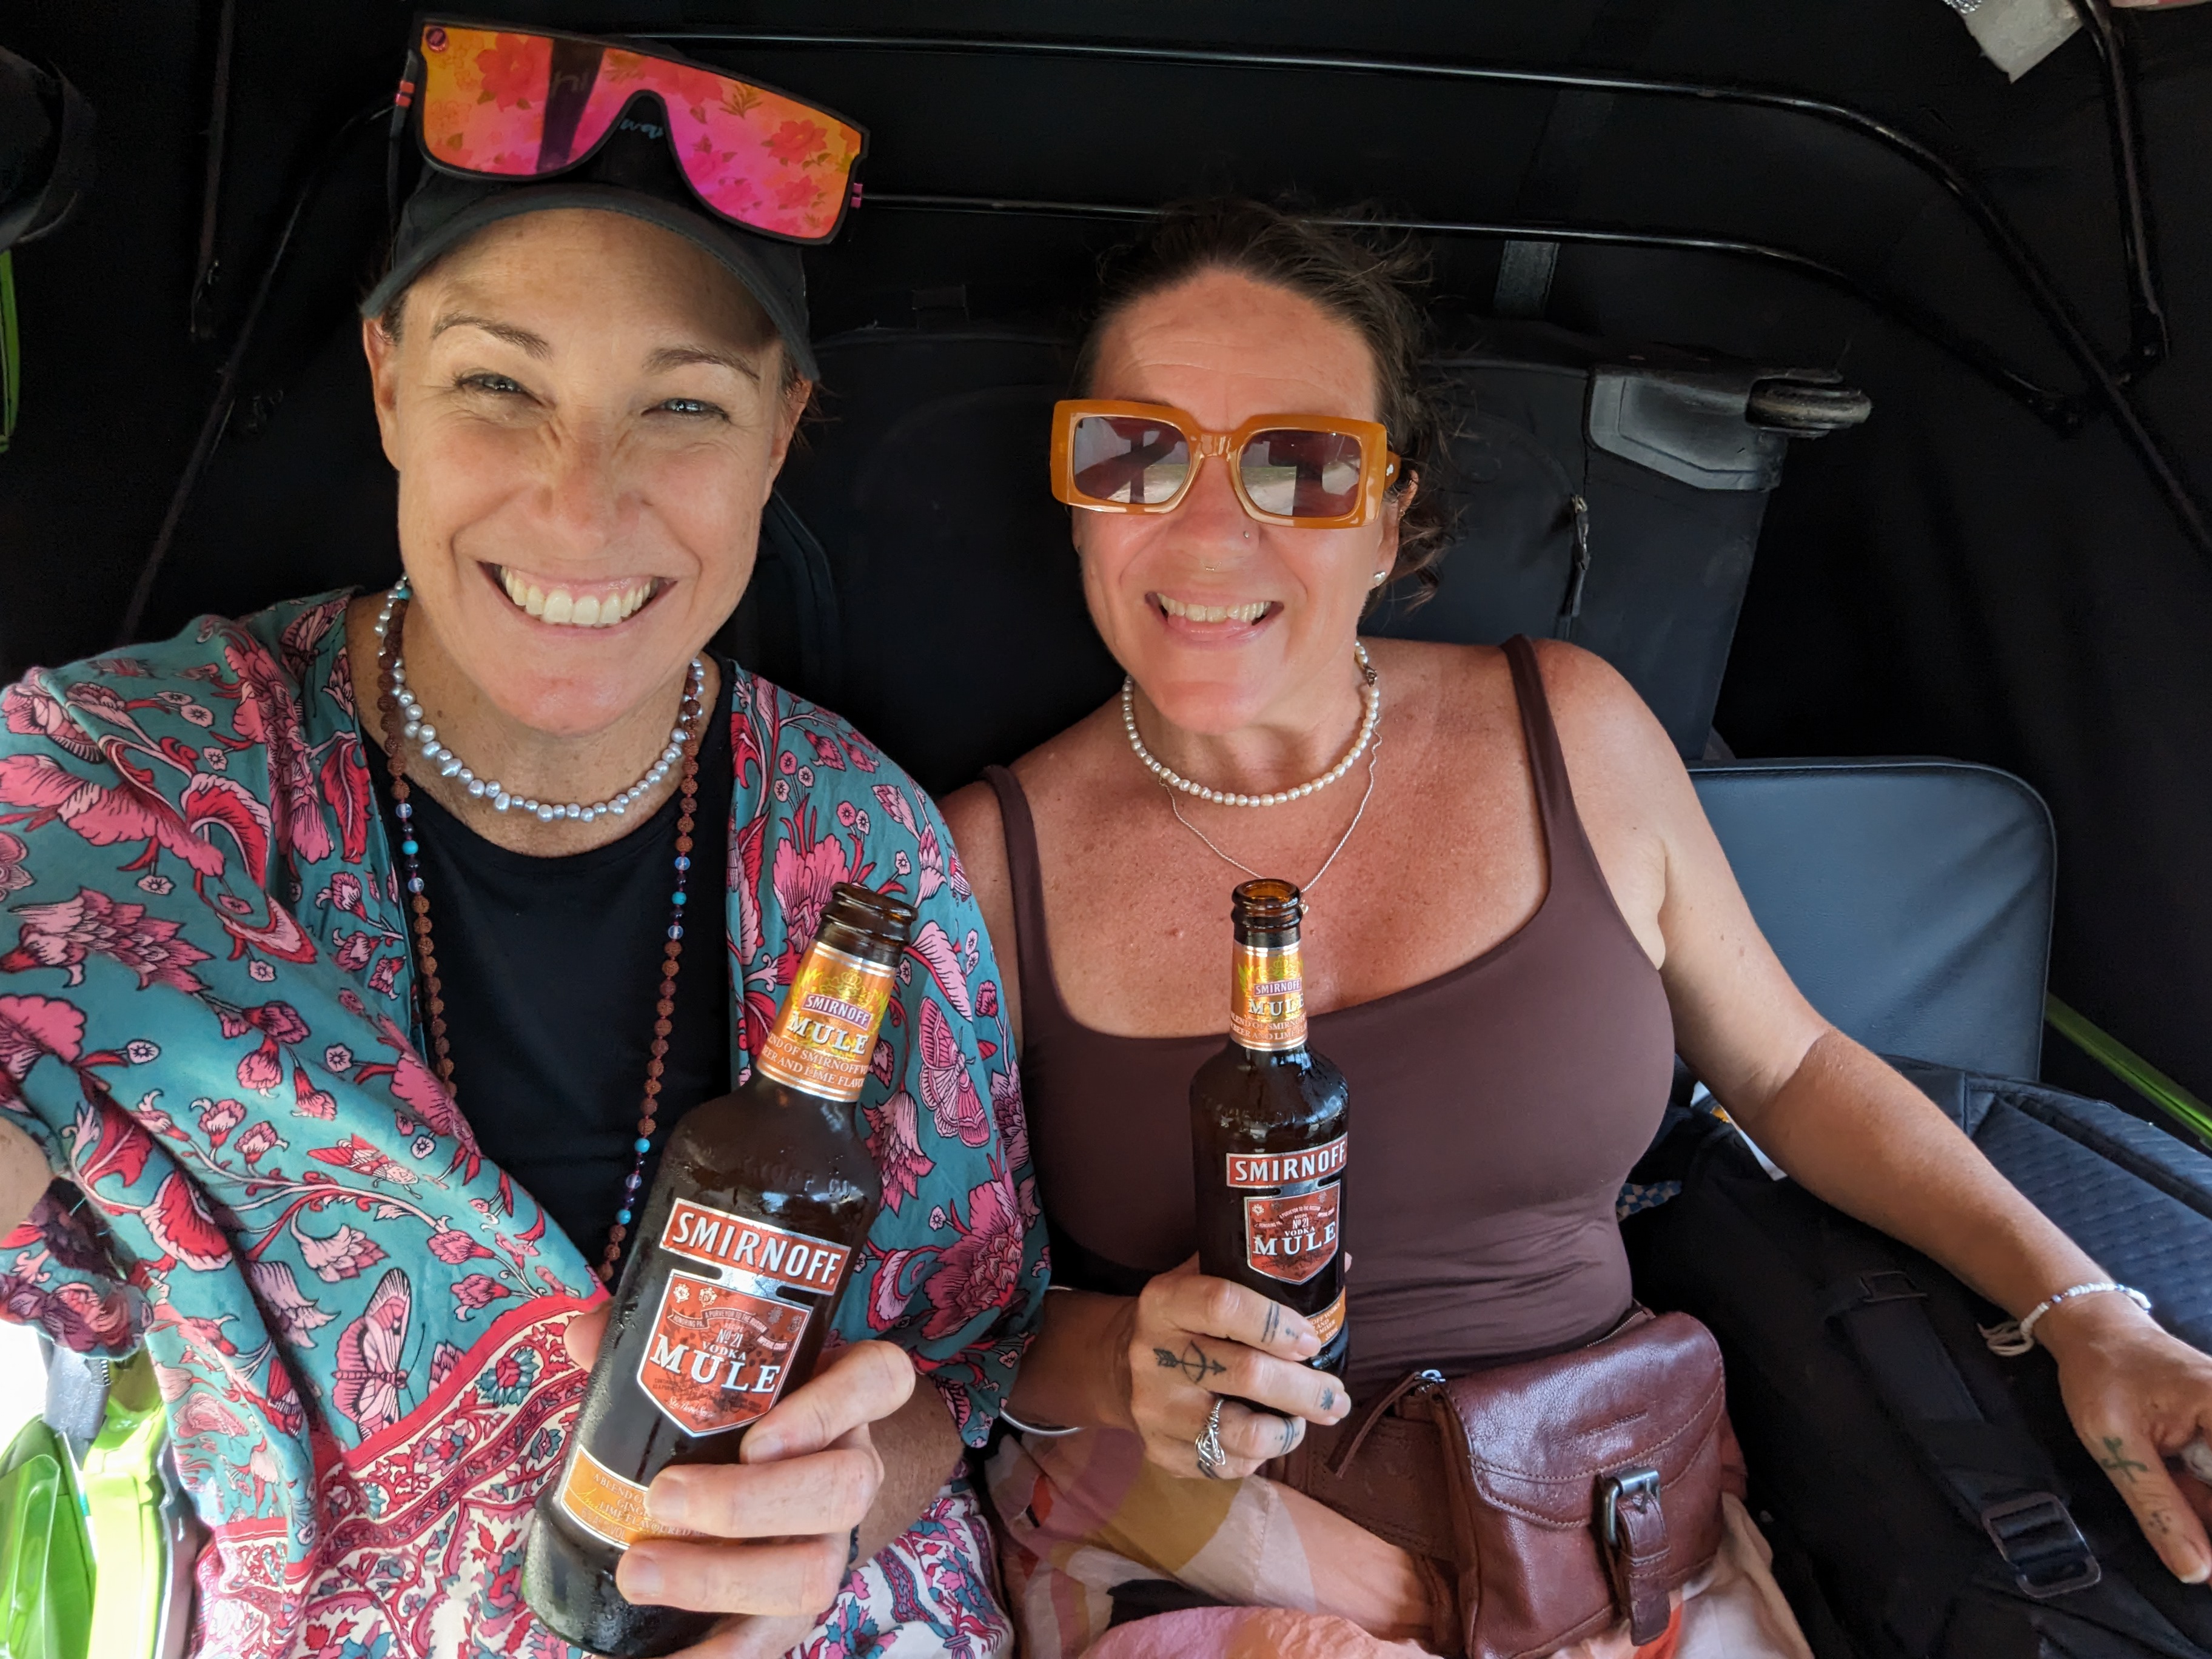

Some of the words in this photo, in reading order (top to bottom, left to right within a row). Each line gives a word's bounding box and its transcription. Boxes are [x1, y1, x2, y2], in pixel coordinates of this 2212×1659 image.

[1256, 979, 1299, 994] SMIRNOFF
[805, 995, 869, 1025] SMIRNOFF
[786, 1010, 869, 1054] MULE
[777, 1057, 803, 1073] AND
[804, 1067, 837, 1084] LIME
[784, 1043, 800, 1057] OF
[800, 1050, 860, 1074] SMIRNOFF
[1235, 1140, 1346, 1182] SMIRNOFF
[1253, 1221, 1336, 1256] MULE
[1285, 1226, 1315, 1236] VODKA
[672, 1212, 842, 1283] SMIRNOFF
[649, 1333, 781, 1392] MULE
[702, 1341, 747, 1361] VODKA
[593, 1473, 599, 1482] A
[600, 1478, 632, 1499] BLEND
[599, 1501, 625, 1518] LIME
[625, 1514, 692, 1536] FLAVOURED
